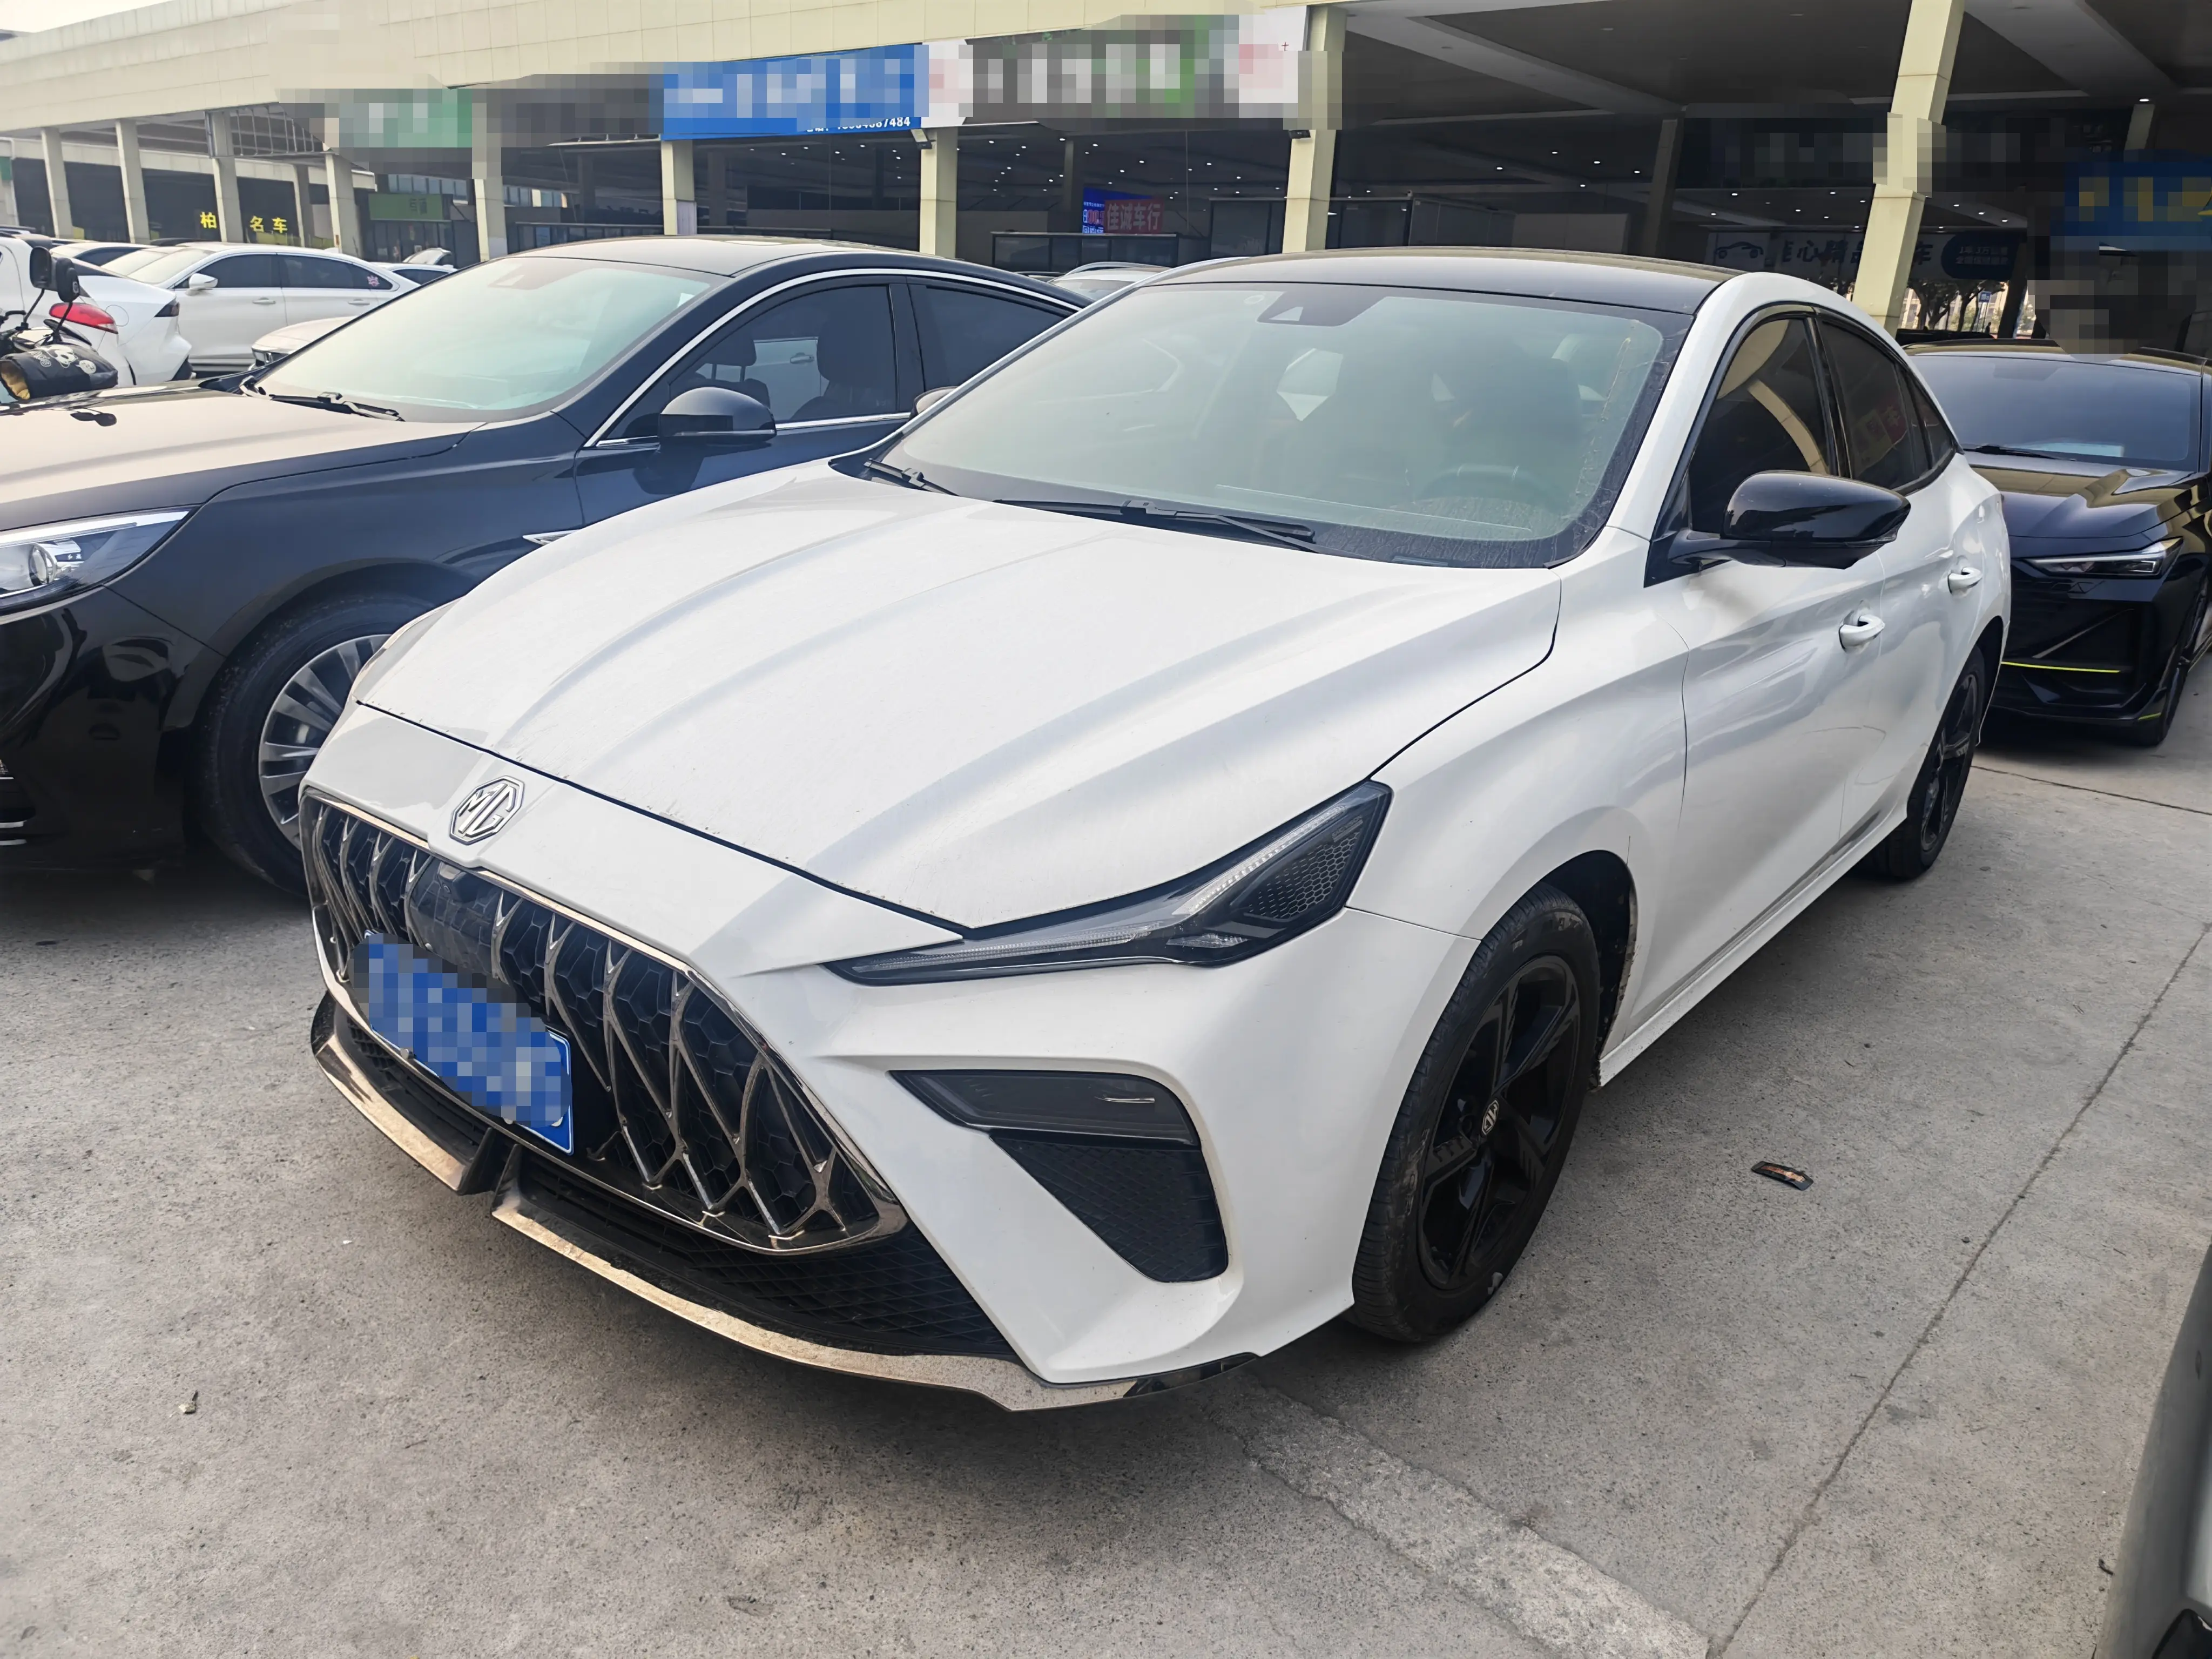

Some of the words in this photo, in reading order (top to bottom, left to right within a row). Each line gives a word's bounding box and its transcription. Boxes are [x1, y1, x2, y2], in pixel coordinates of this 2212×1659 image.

[1107, 203, 1161, 231] 佳诚车行
[457, 782, 517, 838] MG
[1483, 1103, 1498, 1132] MG
